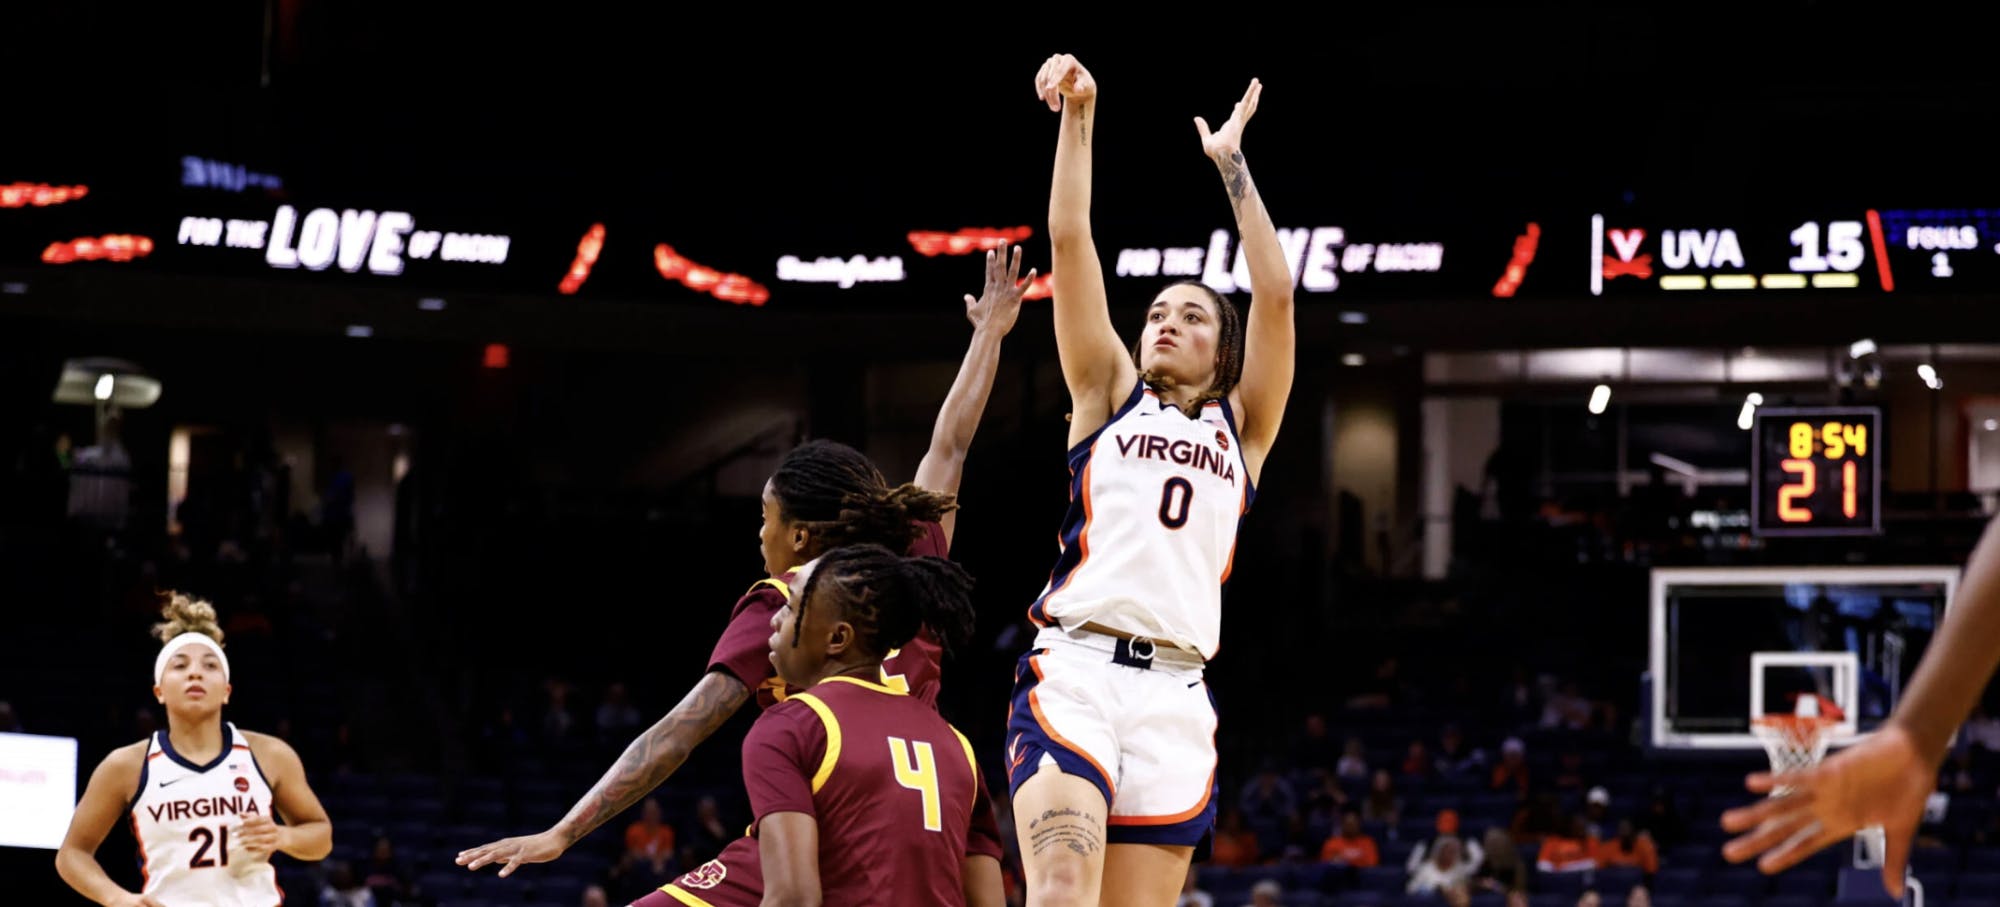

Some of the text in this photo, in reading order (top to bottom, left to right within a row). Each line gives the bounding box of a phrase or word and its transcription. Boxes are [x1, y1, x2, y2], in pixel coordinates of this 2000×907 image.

[178, 217, 223, 246] FOR
[226, 219, 267, 249] THE
[266, 205, 414, 274] LOVE
[408, 231, 440, 259] OF
[1116, 248, 1161, 276] FOR
[1162, 247, 1204, 276] THE
[1341, 244, 1374, 272] OF
[1661, 220, 1865, 272] UVA 15
[1906, 225, 1978, 250] FOULS
[1931, 252, 1953, 277] 1
[1115, 434, 1235, 488] VIRGINIA
[1789, 422, 1867, 459] 8:54
[1158, 476, 1193, 530] 0
[1778, 458, 1856, 523] 21
[887, 736, 942, 832] 4
[148, 796, 259, 822] VIRGINIA
[188, 826, 229, 869] 21
